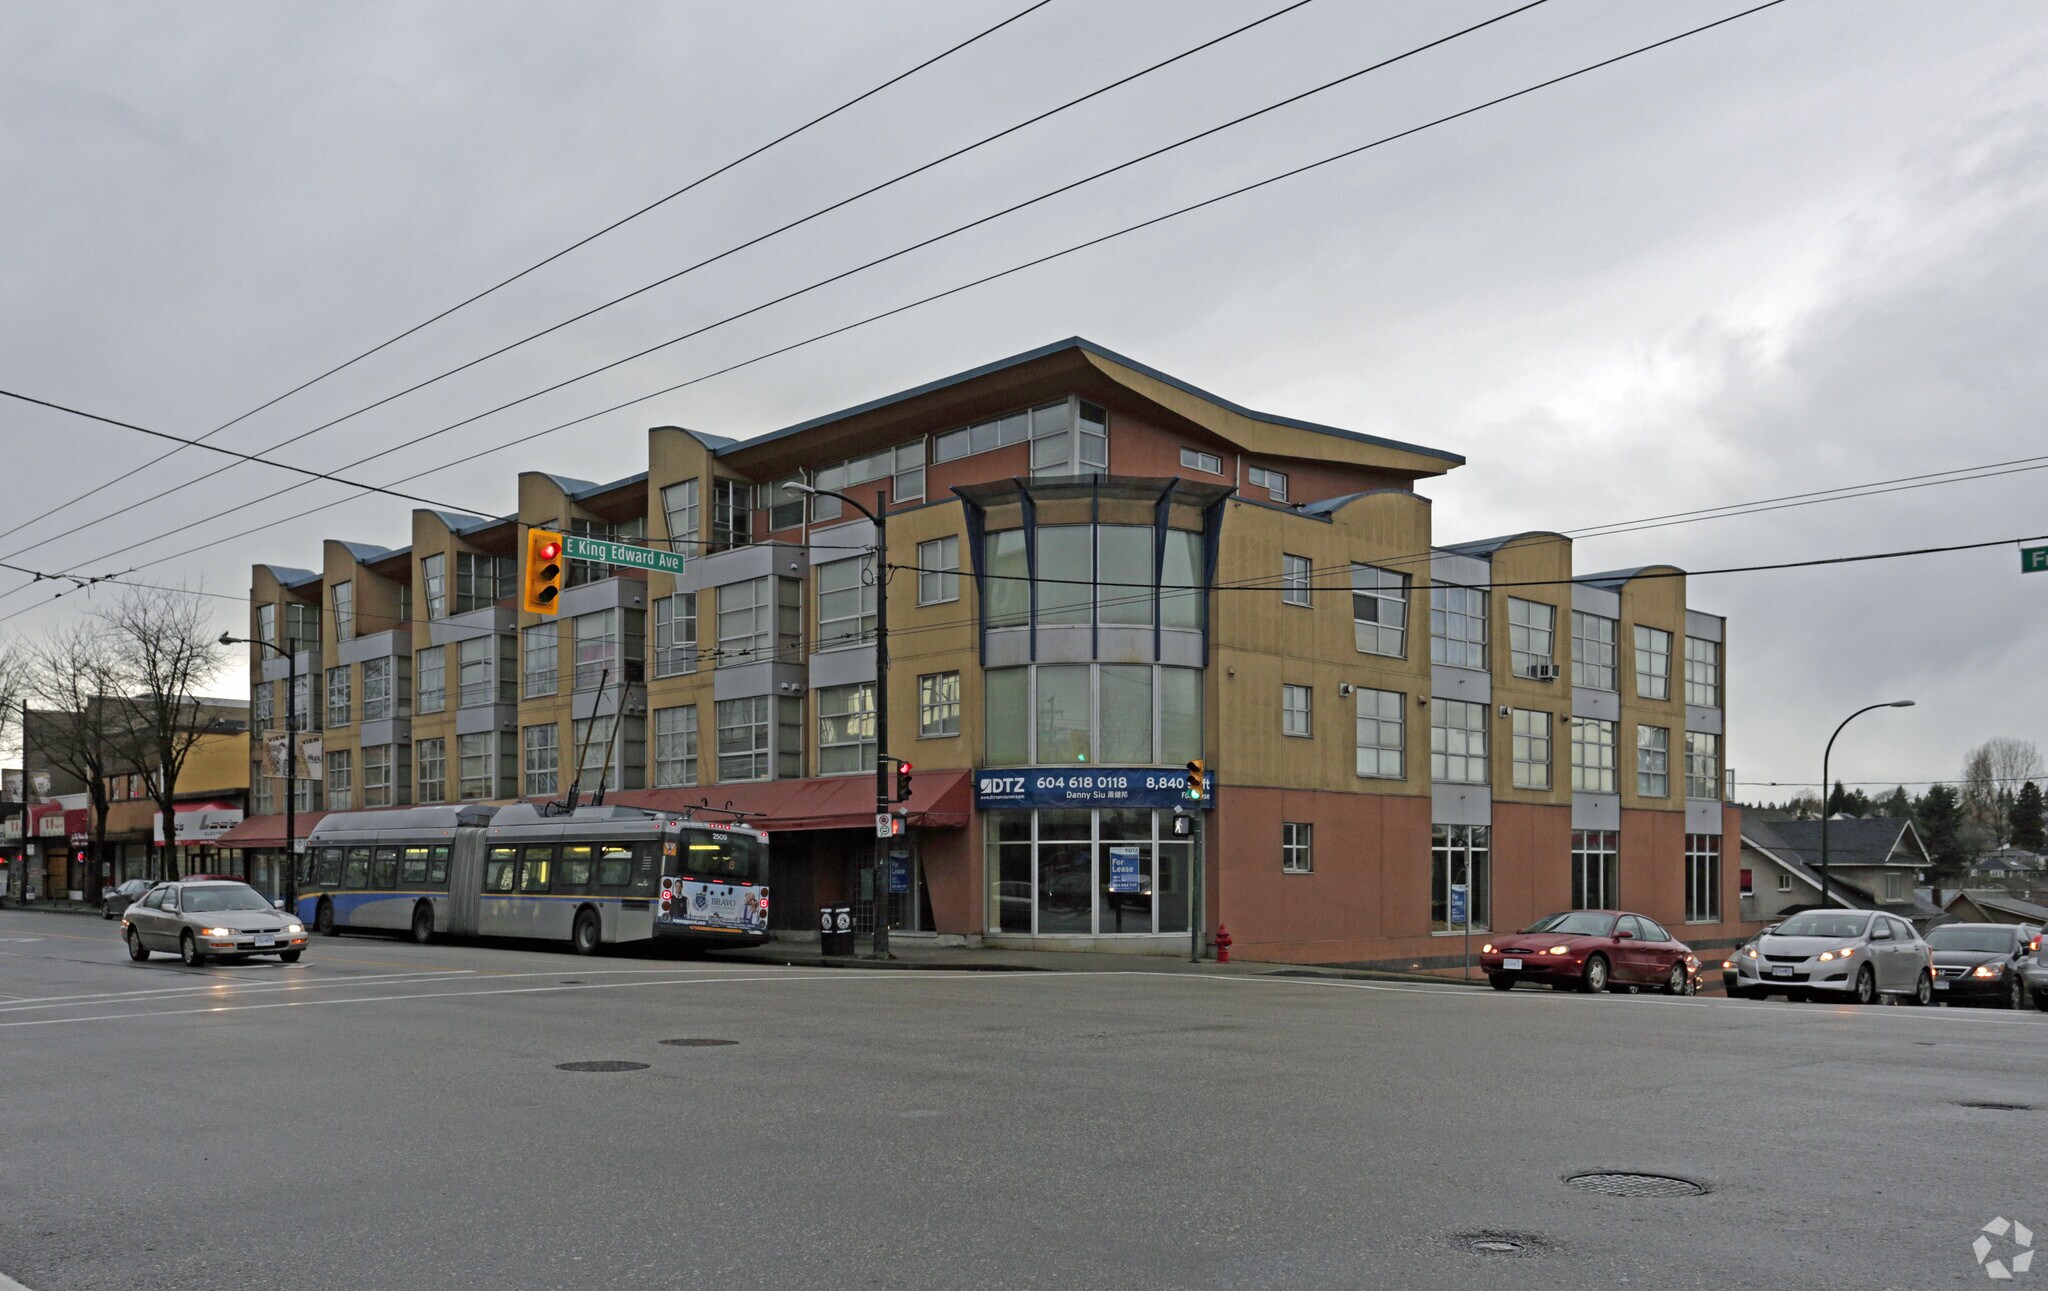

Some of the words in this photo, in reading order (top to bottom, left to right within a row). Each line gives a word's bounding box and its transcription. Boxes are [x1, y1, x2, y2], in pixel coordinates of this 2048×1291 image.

[567, 539, 573, 553] E
[578, 540, 606, 561] King
[611, 547, 654, 565] Edward
[659, 553, 679, 569] Ave
[301, 737, 320, 745] VIEW
[992, 777, 1025, 793] DTZ
[1036, 777, 1065, 789] 604
[1068, 777, 1093, 789] 618
[1097, 777, 1128, 789] 0118
[1146, 777, 1185, 790] 8,840
[1202, 778, 1211, 790] ft
[1066, 791, 1091, 800] Danny
[1093, 791, 1106, 799] Siu
[712, 832, 728, 841] 2509
[1112, 858, 1125, 866] For
[711, 898, 736, 907] BRAVO
